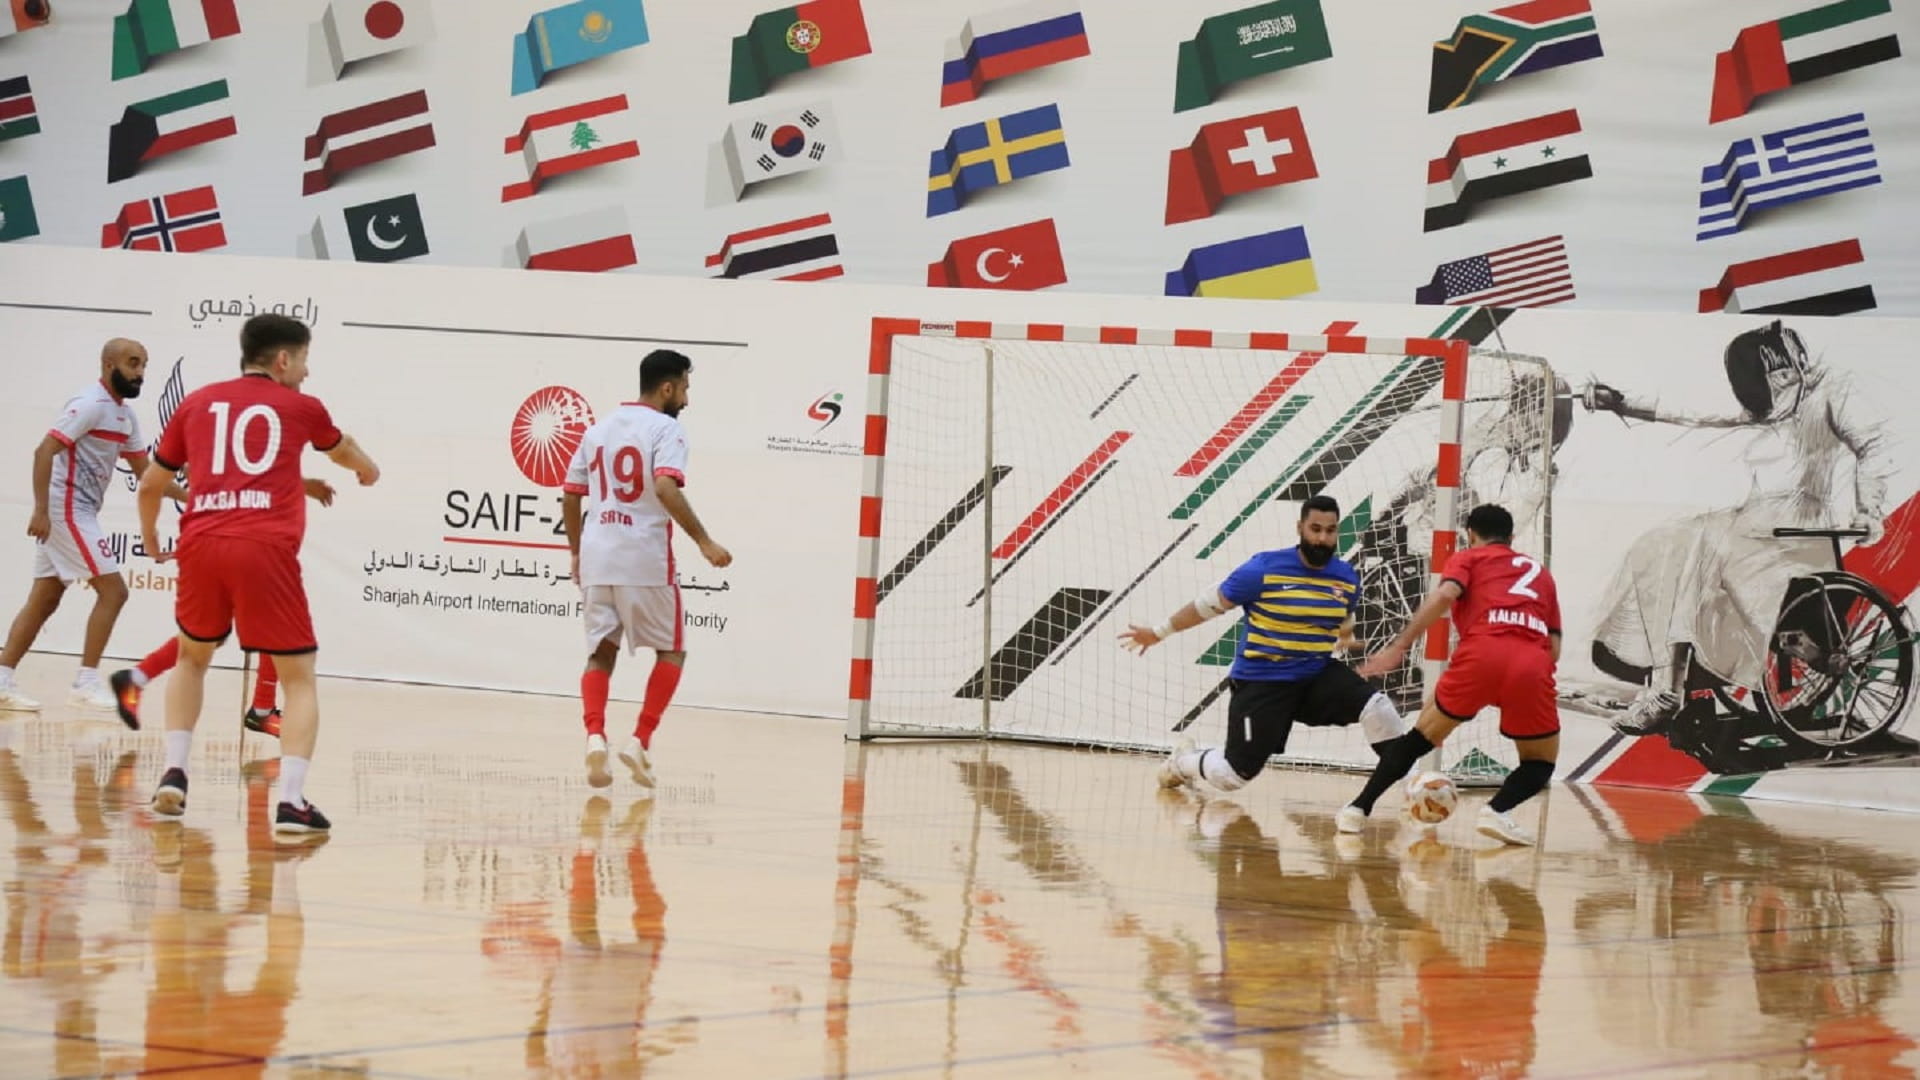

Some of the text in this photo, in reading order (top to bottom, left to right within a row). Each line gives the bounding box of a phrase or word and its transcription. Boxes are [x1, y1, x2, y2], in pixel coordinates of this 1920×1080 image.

[189, 294, 256, 329] ذهبي
[207, 401, 282, 476] 10
[588, 445, 645, 504] 19
[240, 489, 273, 510] MUN
[97, 538, 113, 559] 8
[363, 549, 413, 576] الدولي
[418, 553, 487, 577] الشارقة
[491, 556, 540, 581] لمطار
[1507, 556, 1542, 600] 2
[362, 585, 420, 608] Sharjah
[422, 591, 473, 611] Airport
[477, 595, 571, 617] International
[684, 610, 729, 633] hority
[1243, 716, 1252, 742] 1
